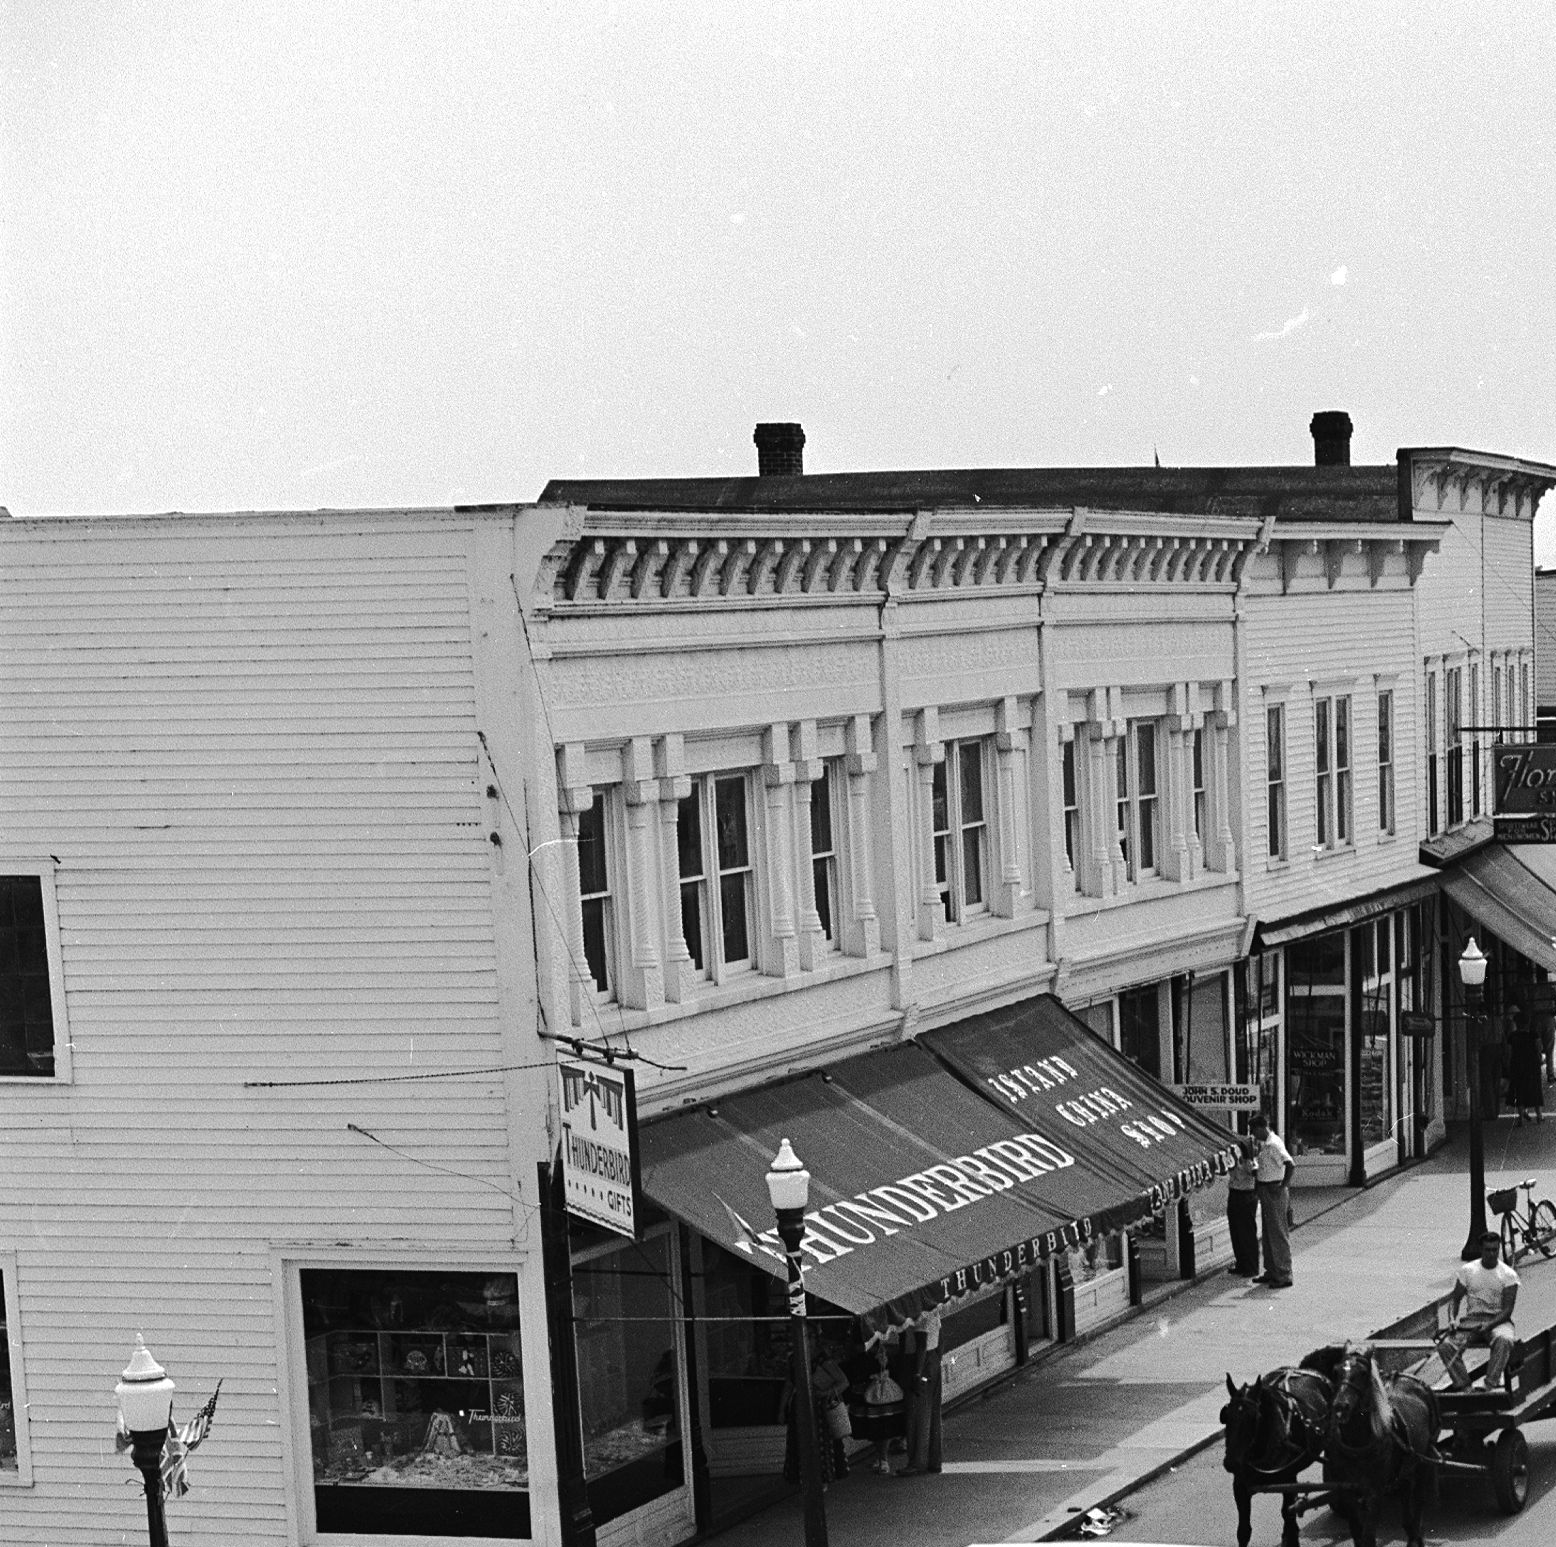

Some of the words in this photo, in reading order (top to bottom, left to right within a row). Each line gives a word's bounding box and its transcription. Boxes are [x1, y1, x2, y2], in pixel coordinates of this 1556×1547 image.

[988, 1055, 1079, 1104] ISLAND
[1183, 1086, 1208, 1095] JOHN
[1221, 1087, 1250, 1095] DOUD
[1056, 1086, 1133, 1127] CHINA
[1183, 1095, 1226, 1104] OUVENIR
[1229, 1095, 1257, 1104] SHOP
[1120, 1109, 1186, 1148] SHOP
[563, 1122, 631, 1187] THUNDERBIRD
[607, 1190, 632, 1217] GIFTS
